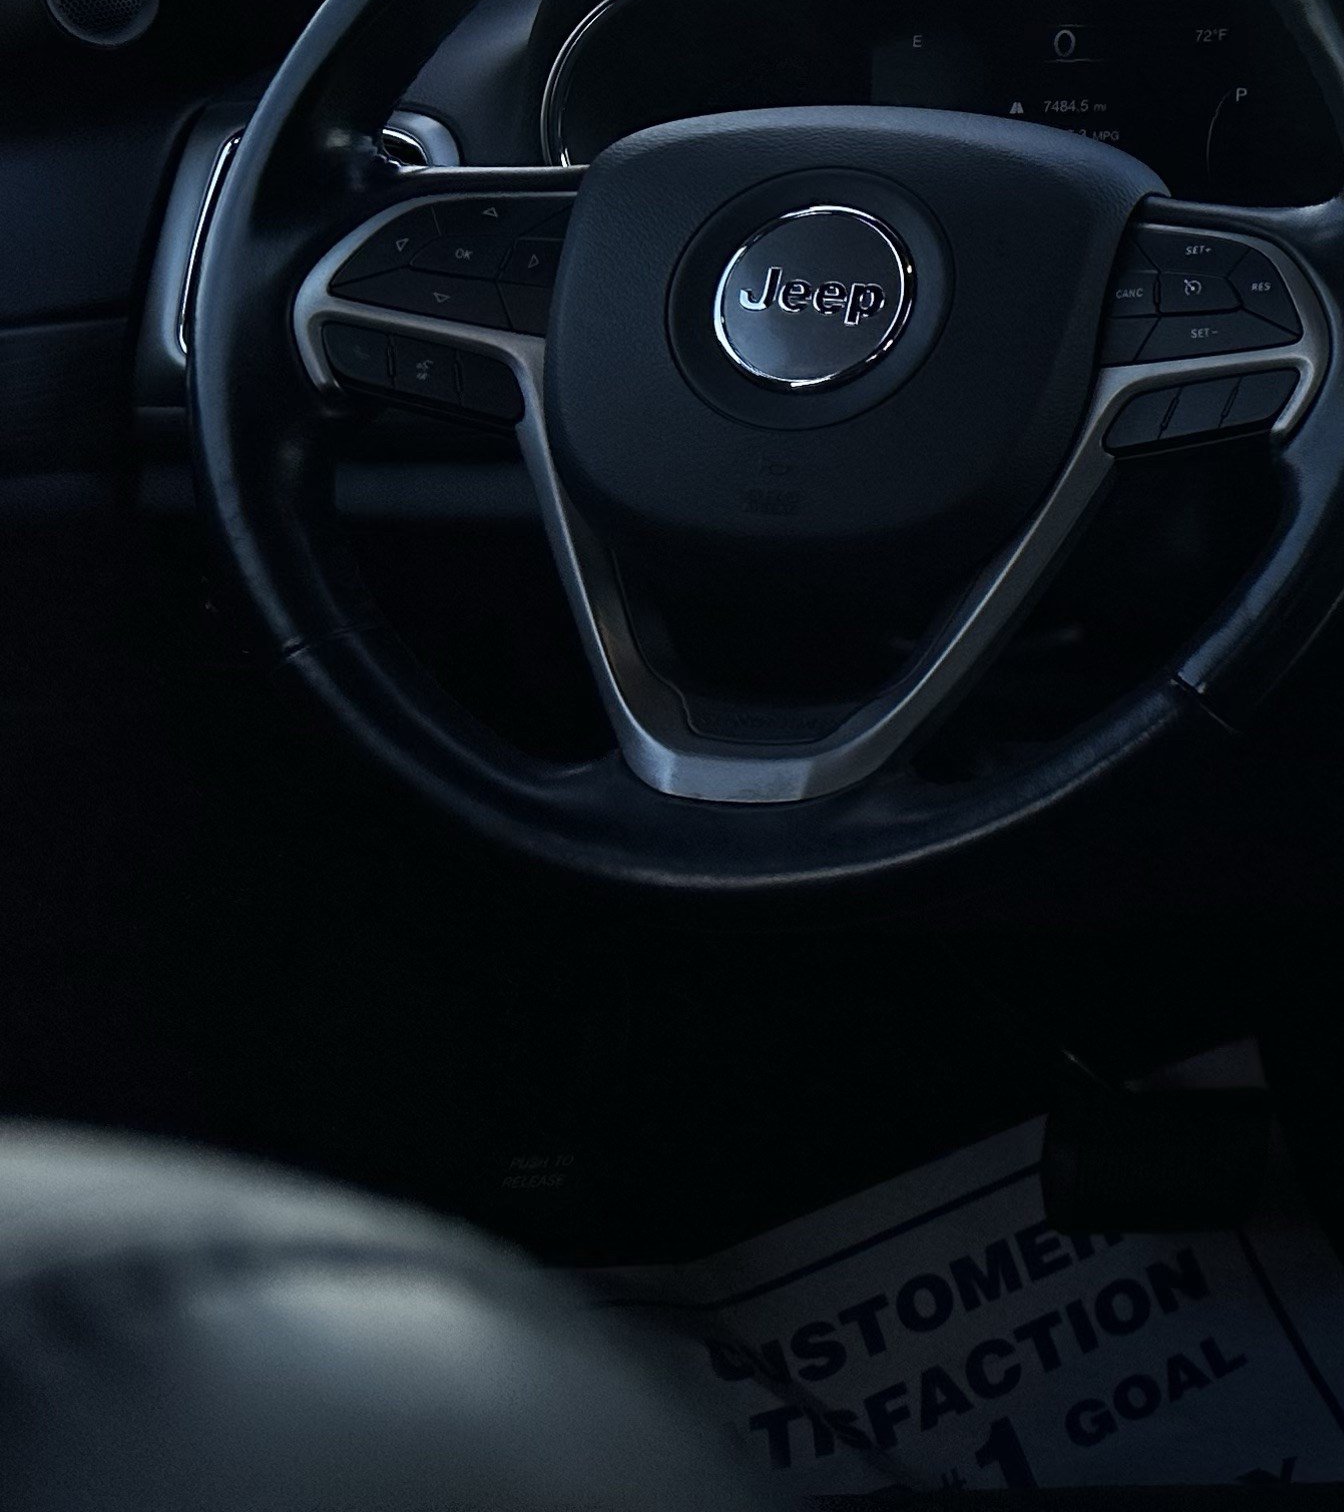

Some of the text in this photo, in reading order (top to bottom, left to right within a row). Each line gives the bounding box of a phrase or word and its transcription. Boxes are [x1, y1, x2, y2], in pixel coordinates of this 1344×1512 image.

[1234, 87, 1248, 103] P
[1043, 99, 1089, 113] 7484.5
[455, 248, 474, 262] OK
[1251, 281, 1271, 292] RES
[739, 265, 887, 327] Jeep
[1115, 288, 1144, 300] CANC
[1064, 1336, 1250, 1448] GOAL
